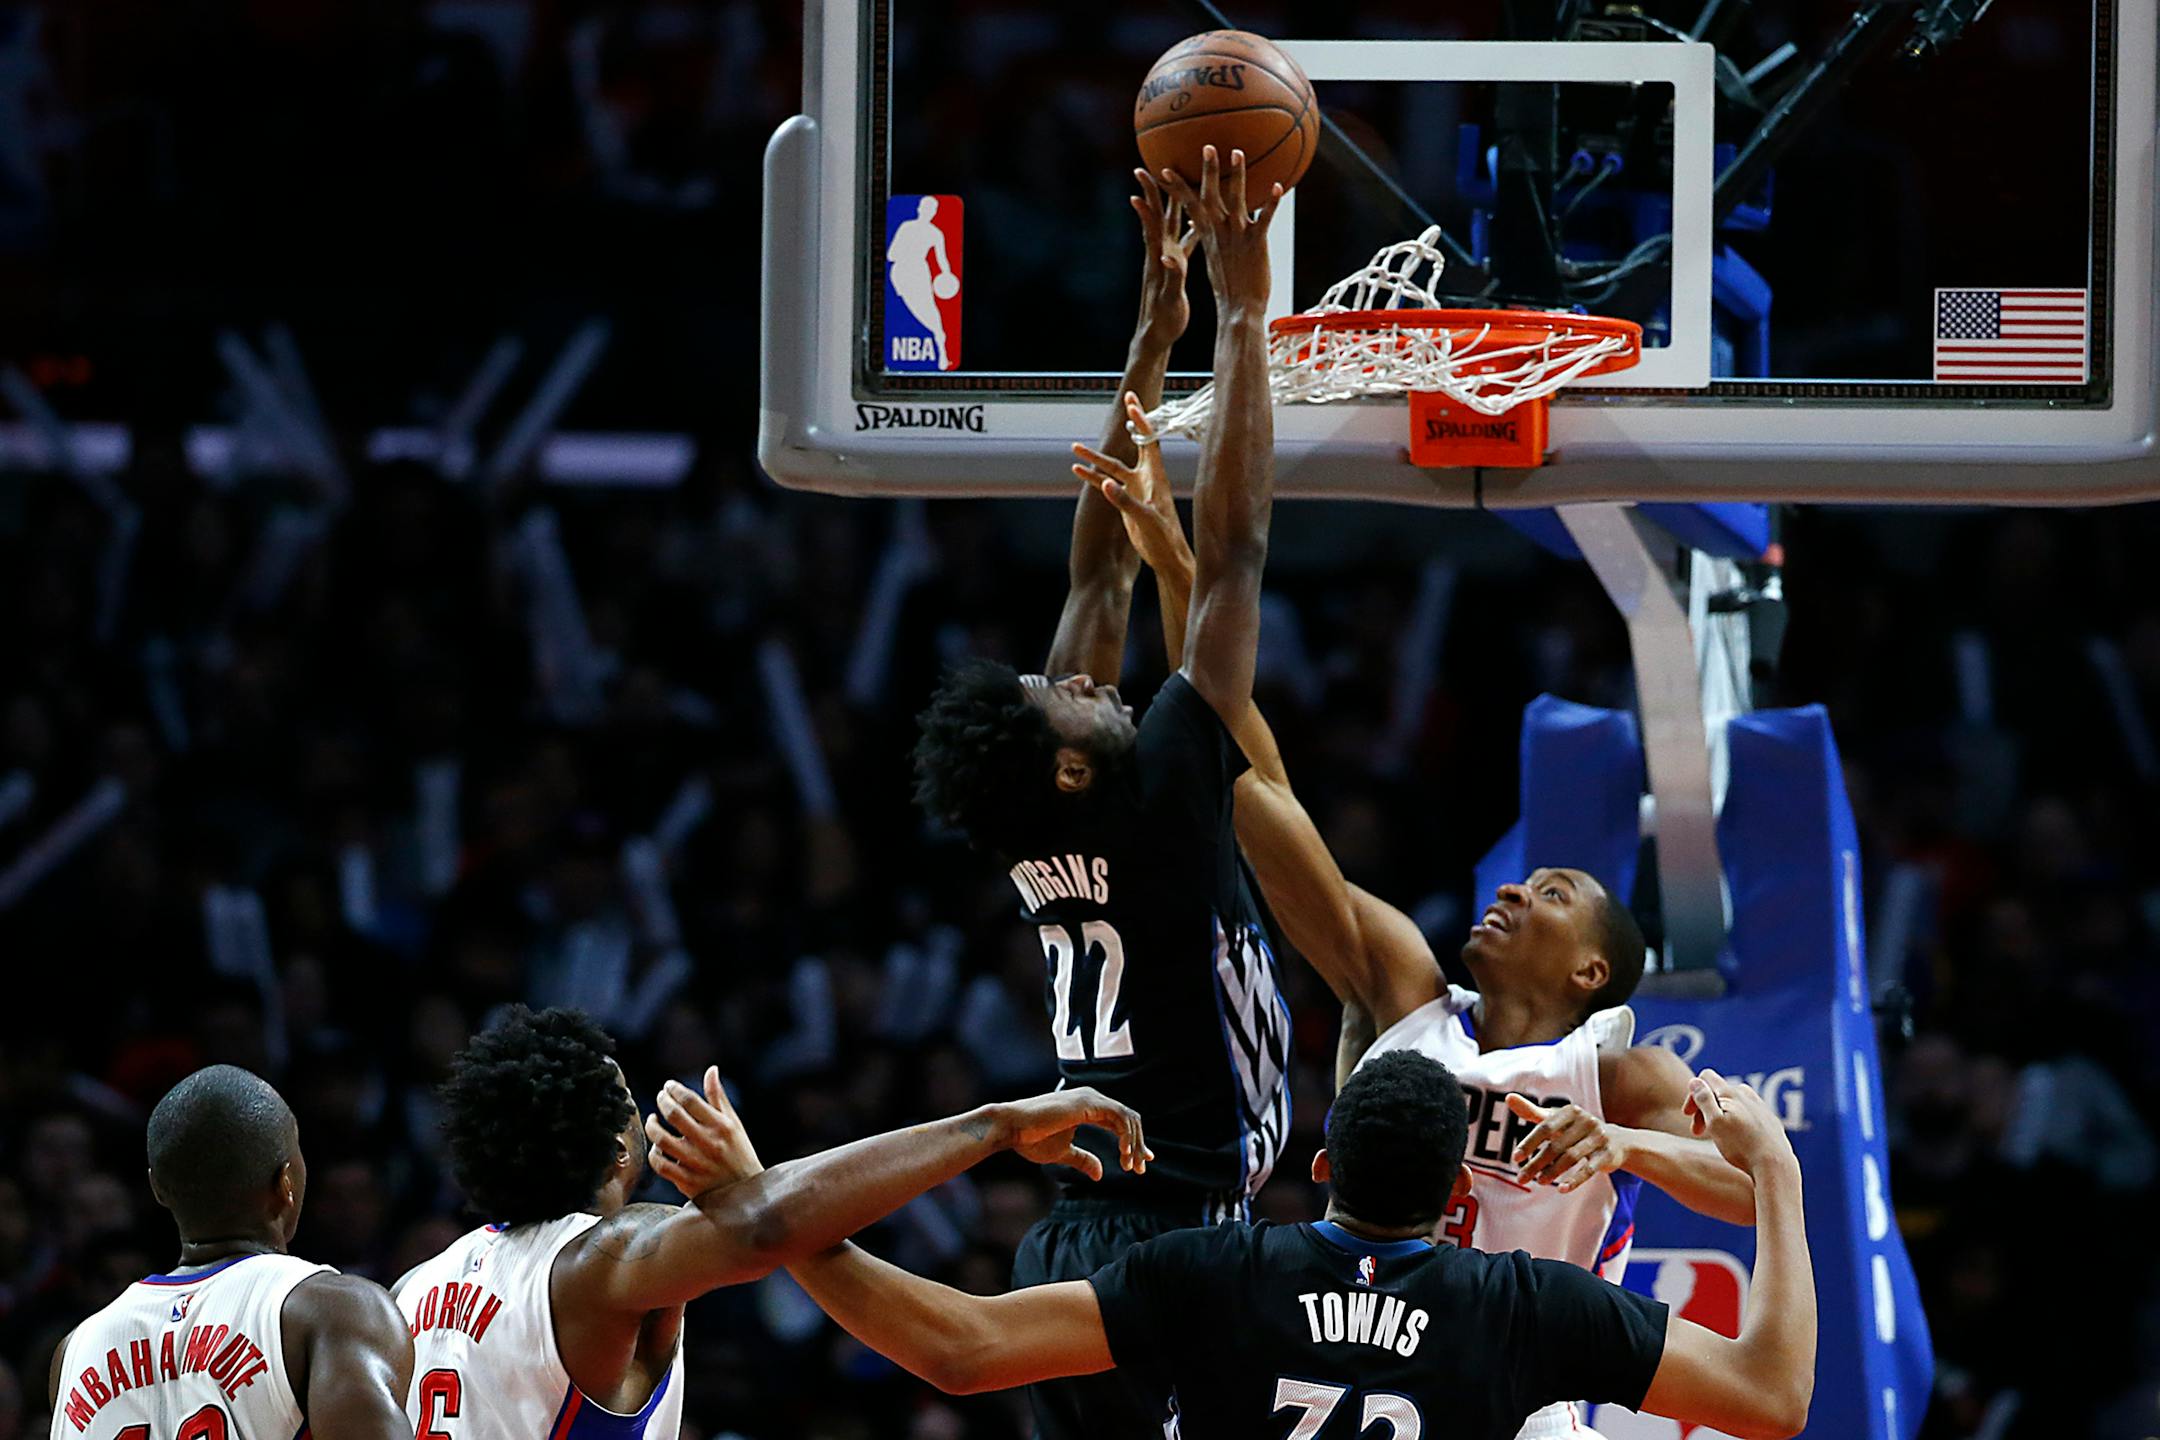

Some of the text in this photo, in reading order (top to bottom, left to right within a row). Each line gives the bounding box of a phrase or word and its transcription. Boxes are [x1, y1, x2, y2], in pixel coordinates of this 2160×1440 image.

[892, 337, 936, 361] NBA
[855, 404, 988, 433] SPALDING
[1425, 419, 1517, 442] SPALDING
[1009, 854, 1108, 914] WIGGINS
[1038, 920, 1134, 1060] 22
[409, 1281, 503, 1344] JORDAN
[1298, 1292, 1429, 1357] TOWNS
